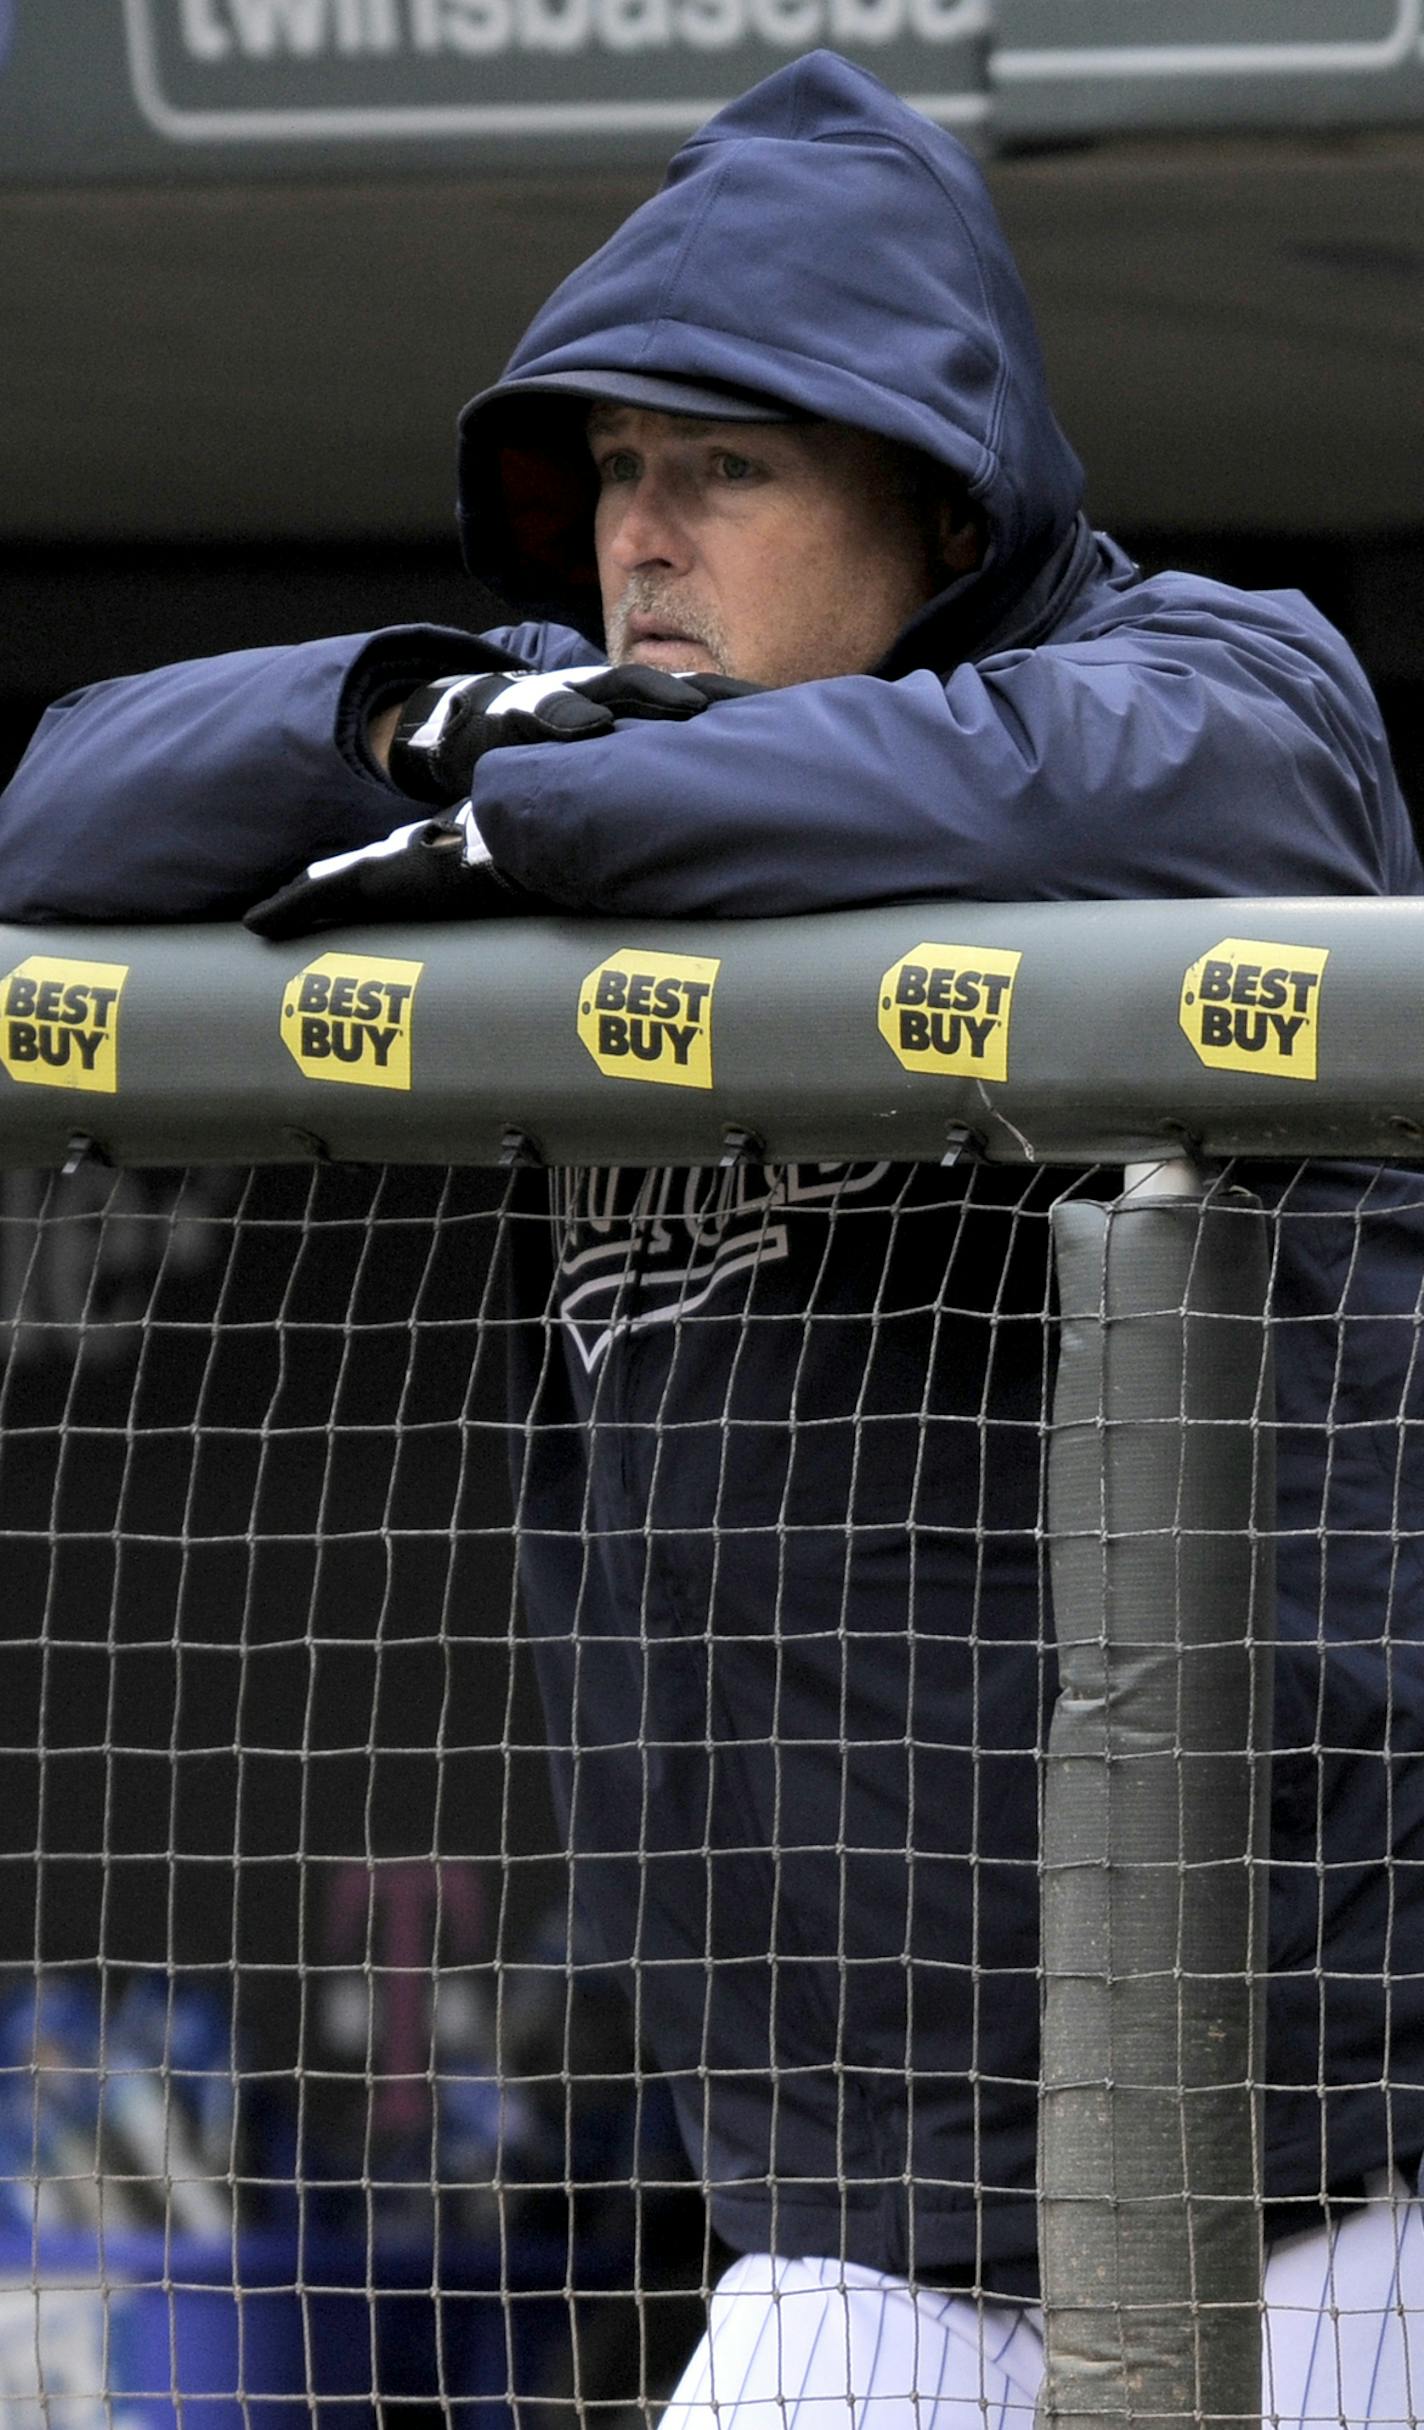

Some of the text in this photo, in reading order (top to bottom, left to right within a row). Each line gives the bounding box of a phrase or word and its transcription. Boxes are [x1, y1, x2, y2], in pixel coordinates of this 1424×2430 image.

[4, 978, 117, 1028] BEST
[297, 974, 411, 1025] BEST
[594, 971, 710, 1023] BEST
[895, 965, 1011, 1016] BEST
[1198, 961, 1318, 1014] BEST
[9, 1020, 109, 1070] BUY
[301, 1017, 402, 1067] BUY
[599, 1015, 700, 1066] BUY
[899, 1010, 999, 1058] BUY
[1201, 1005, 1307, 1057] BUY
